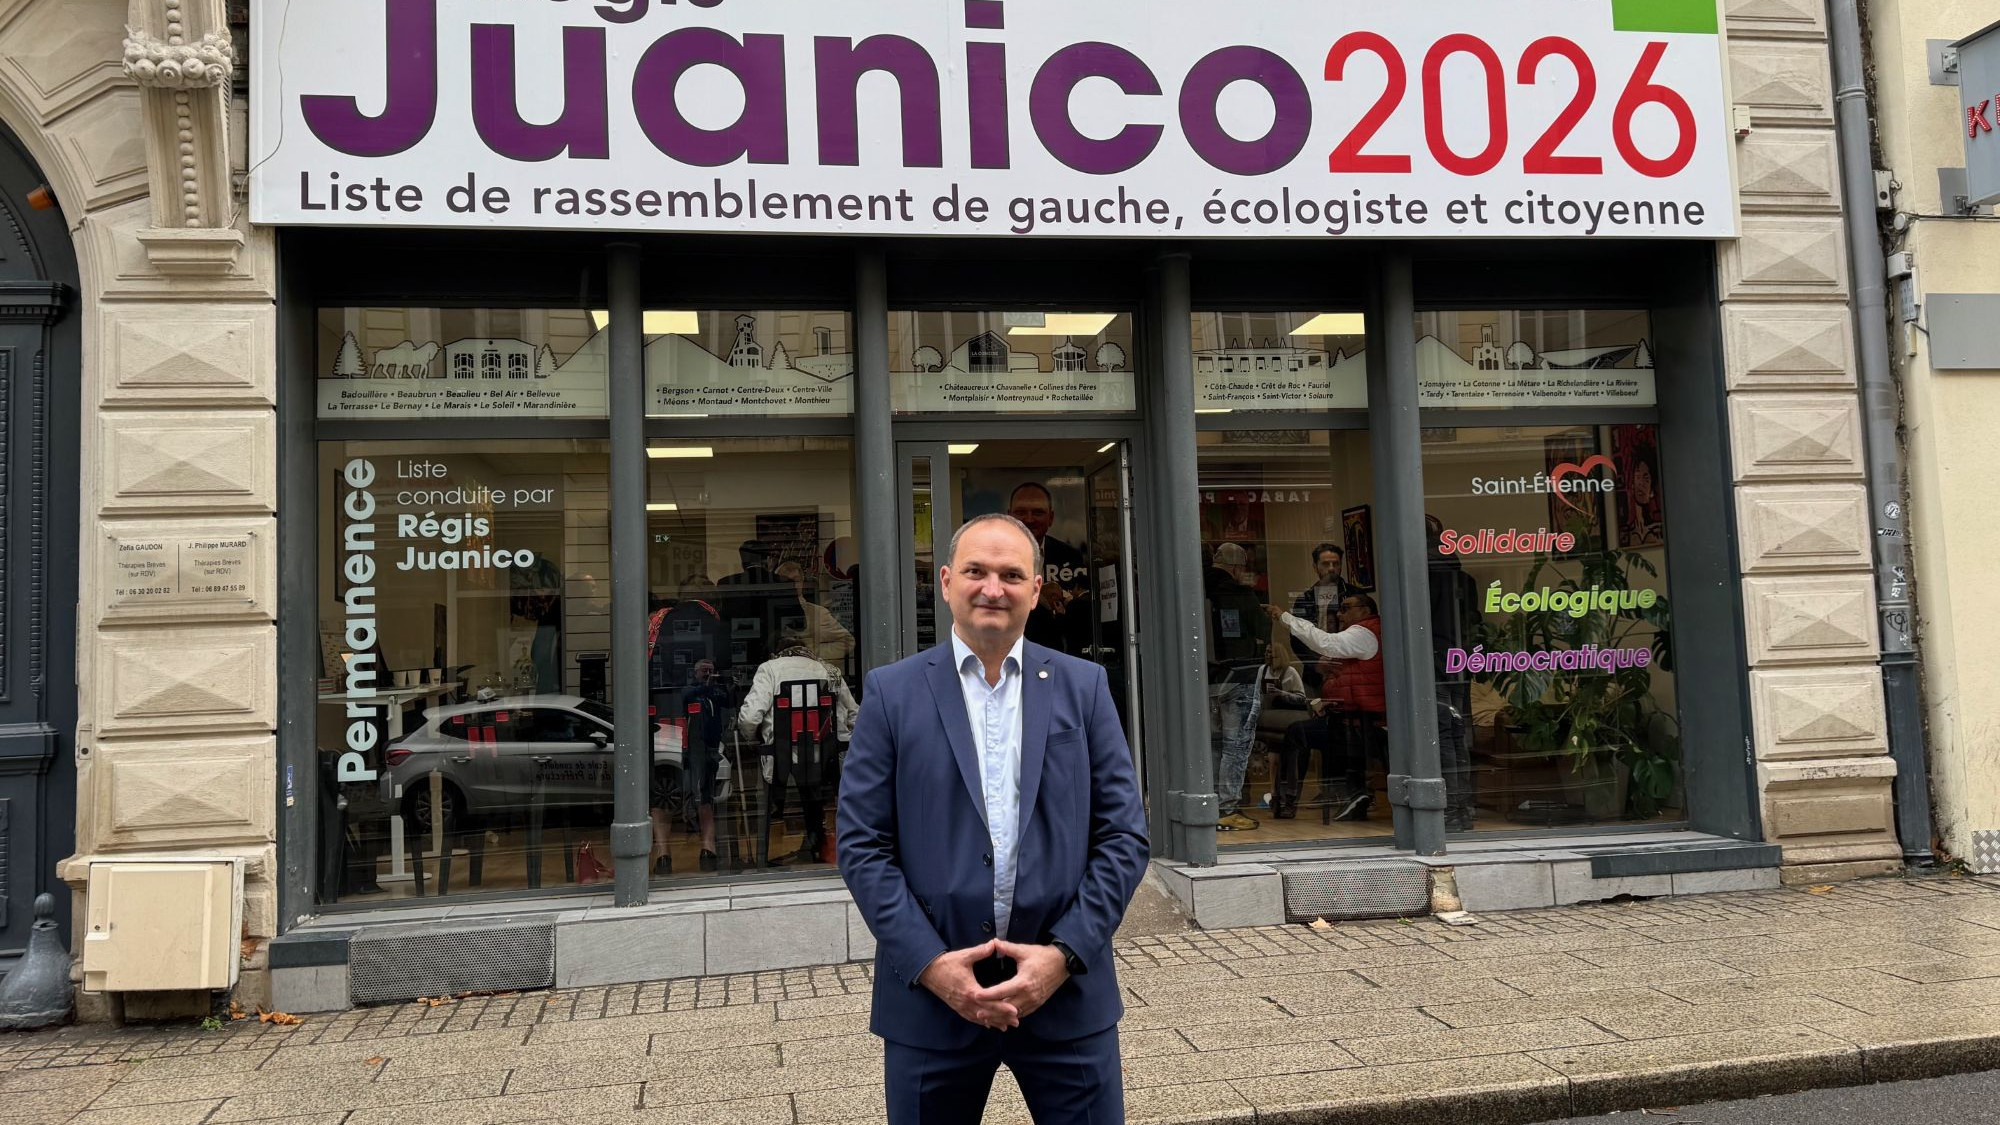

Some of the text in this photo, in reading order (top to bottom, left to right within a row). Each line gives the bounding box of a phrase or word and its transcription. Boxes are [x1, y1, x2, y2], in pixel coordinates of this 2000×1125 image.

[300, 0, 1698, 178] Juanico 2026
[300, 171, 1706, 236] Liste de rassemblement de gauche, écologiste et citoyenne
[662, 387, 694, 395] Bergson
[1424, 381, 1456, 389] Jomayère
[328, 402, 337, 410] La
[381, 402, 390, 410] Le
[393, 402, 422, 411] Bernay
[397, 460, 447, 478] Liste
[1471, 472, 1615, 494] Saint-Étienne
[397, 486, 554, 507] conduite par
[398, 511, 490, 544] Régis
[1439, 528, 1575, 555] Solidaire
[396, 545, 534, 570] Juanico
[1484, 580, 1657, 618] Écologique
[338, 458, 377, 782] Permanence
[1446, 644, 1651, 674] Démocratique
